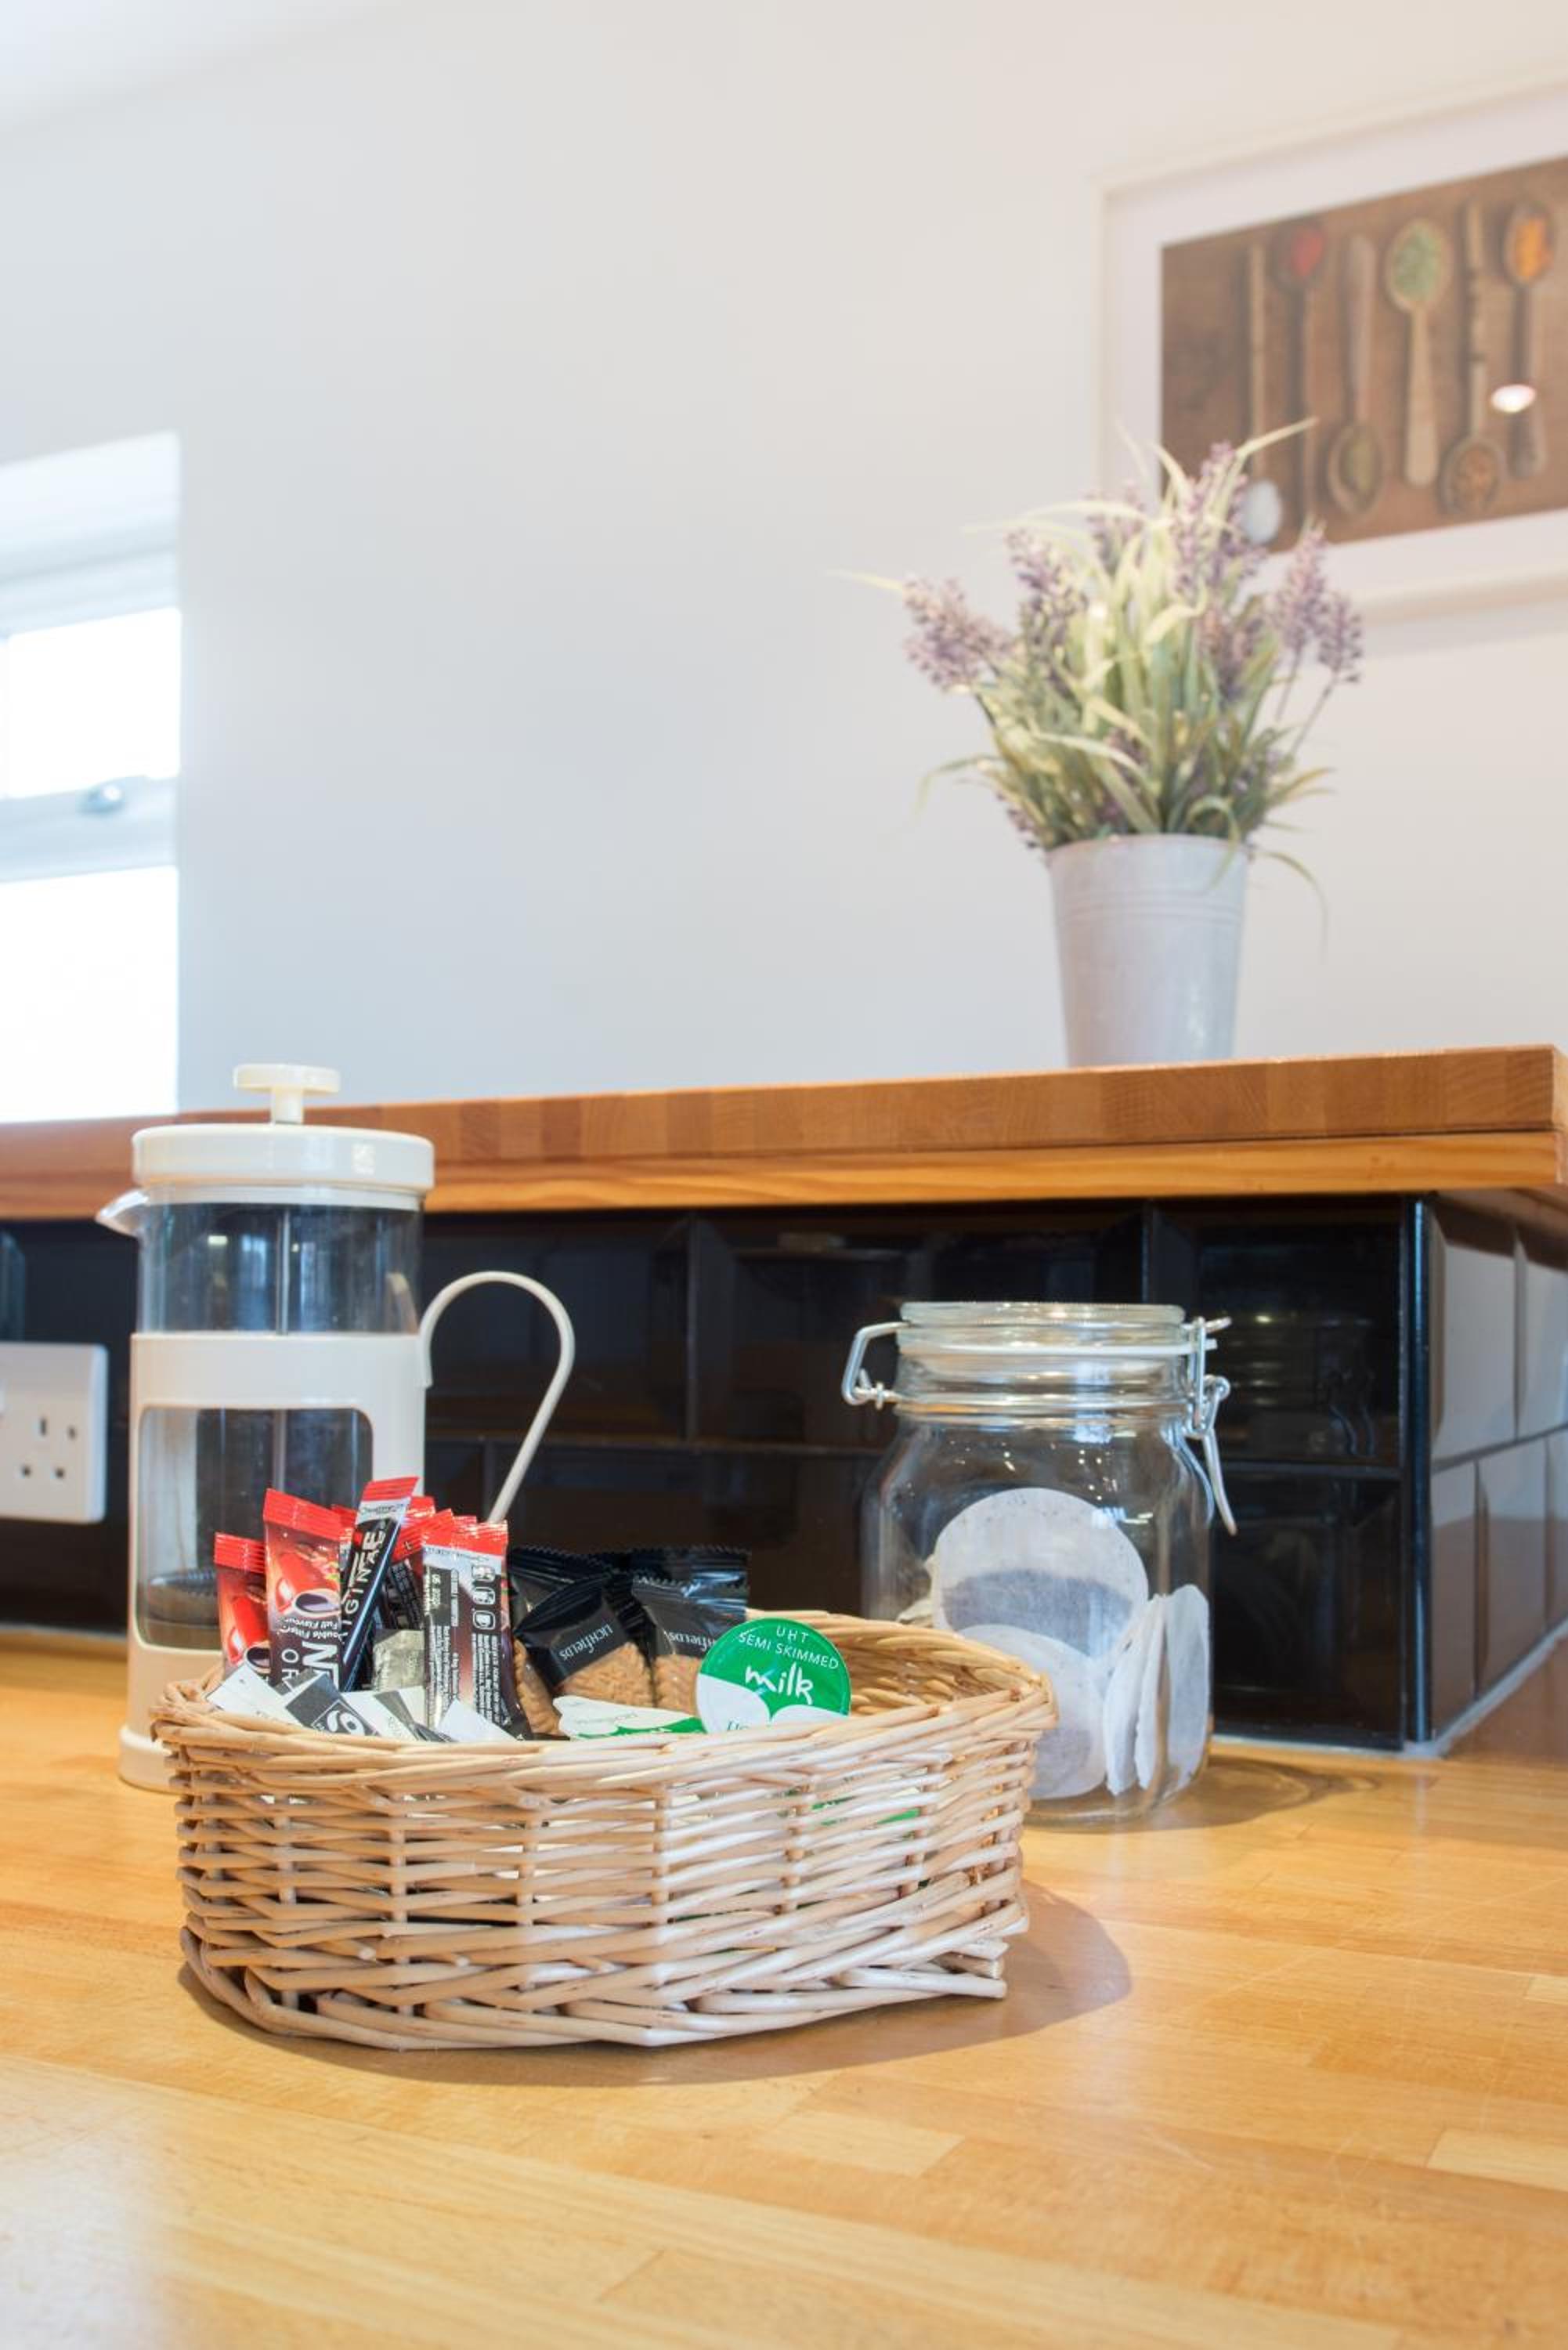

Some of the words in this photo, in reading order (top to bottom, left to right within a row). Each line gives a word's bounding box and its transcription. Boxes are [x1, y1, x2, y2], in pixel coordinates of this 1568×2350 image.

[739, 1632, 771, 1650] SEMI
[775, 1643, 840, 1670] SKIMMED
[776, 1625, 809, 1643] UHT
[746, 1661, 814, 1705] milk
